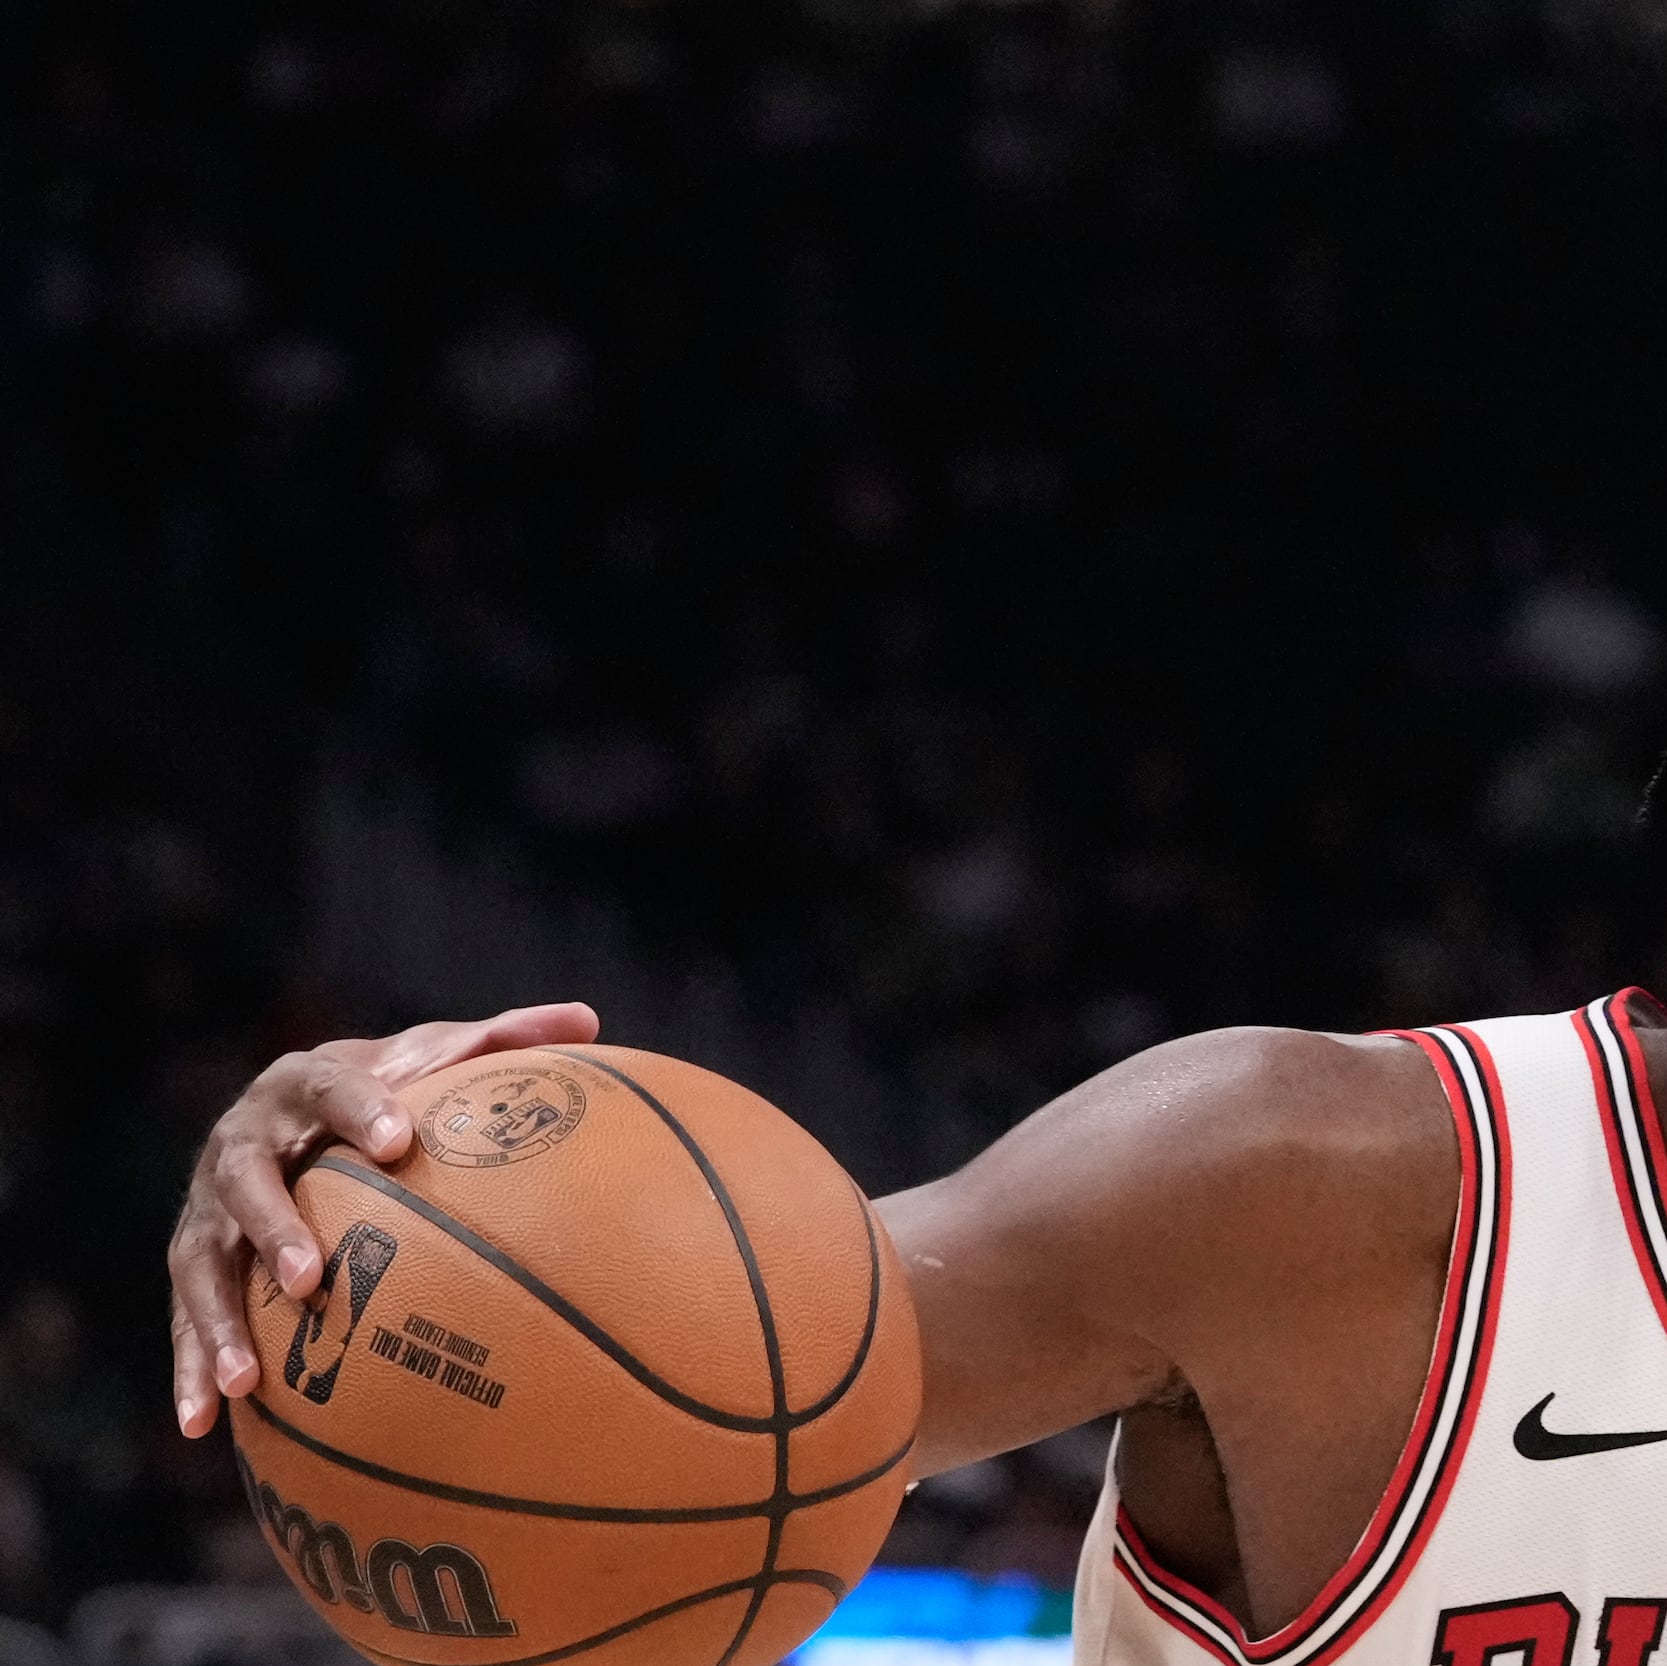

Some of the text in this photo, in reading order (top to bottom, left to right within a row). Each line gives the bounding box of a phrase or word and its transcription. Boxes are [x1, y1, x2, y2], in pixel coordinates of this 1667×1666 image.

[368, 1327, 506, 1409] OFFICIAL GAME BALL
[402, 1314, 490, 1368] GENUINE LEATHER
